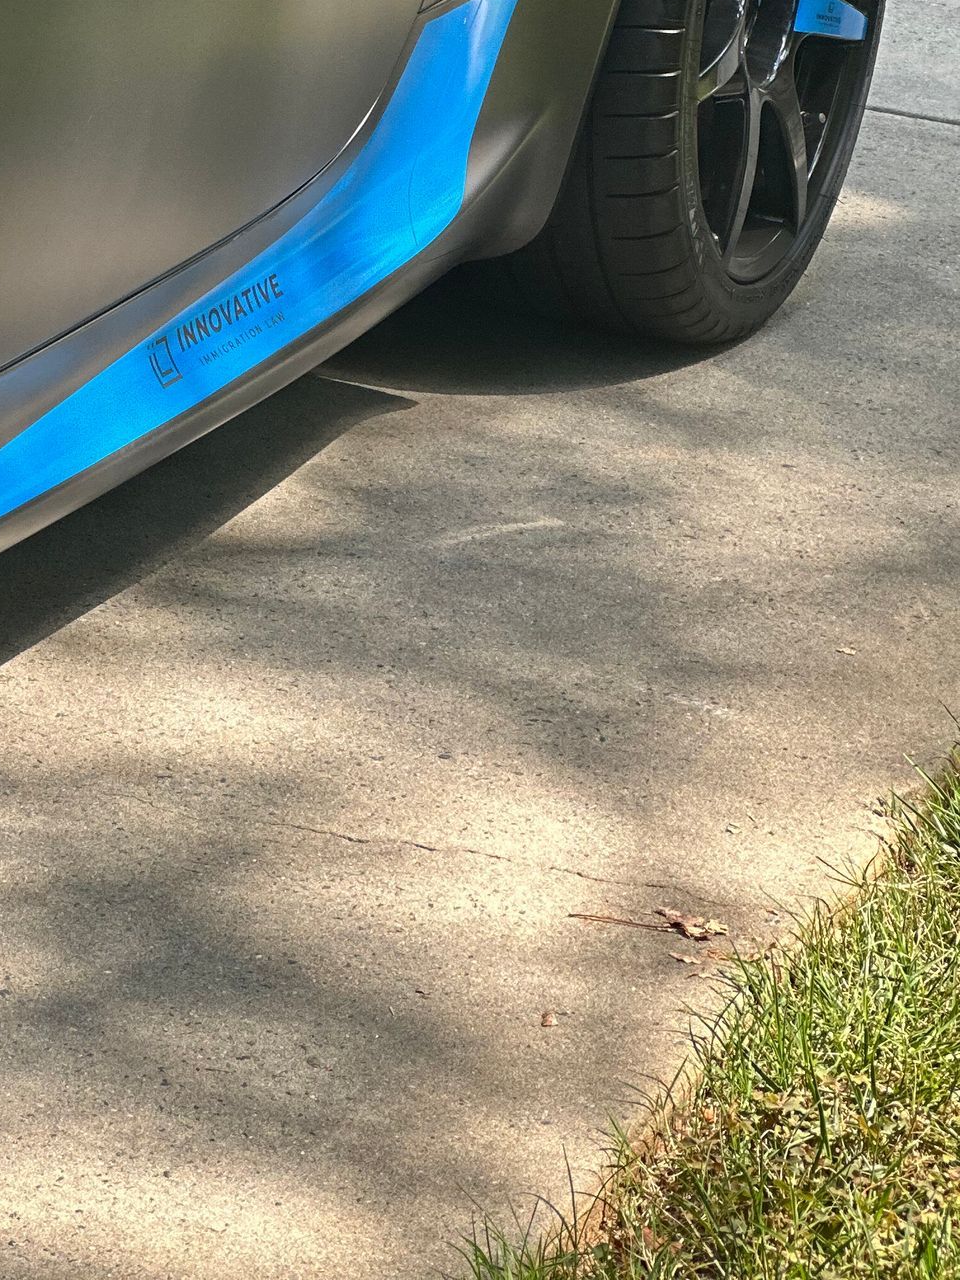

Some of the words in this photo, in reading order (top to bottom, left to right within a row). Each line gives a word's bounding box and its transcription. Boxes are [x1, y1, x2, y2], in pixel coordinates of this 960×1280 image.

[177, 273, 284, 352] INNOVATIVE
[199, 325, 262, 366] IMMIGRATION
[266, 311, 286, 328] LAW
